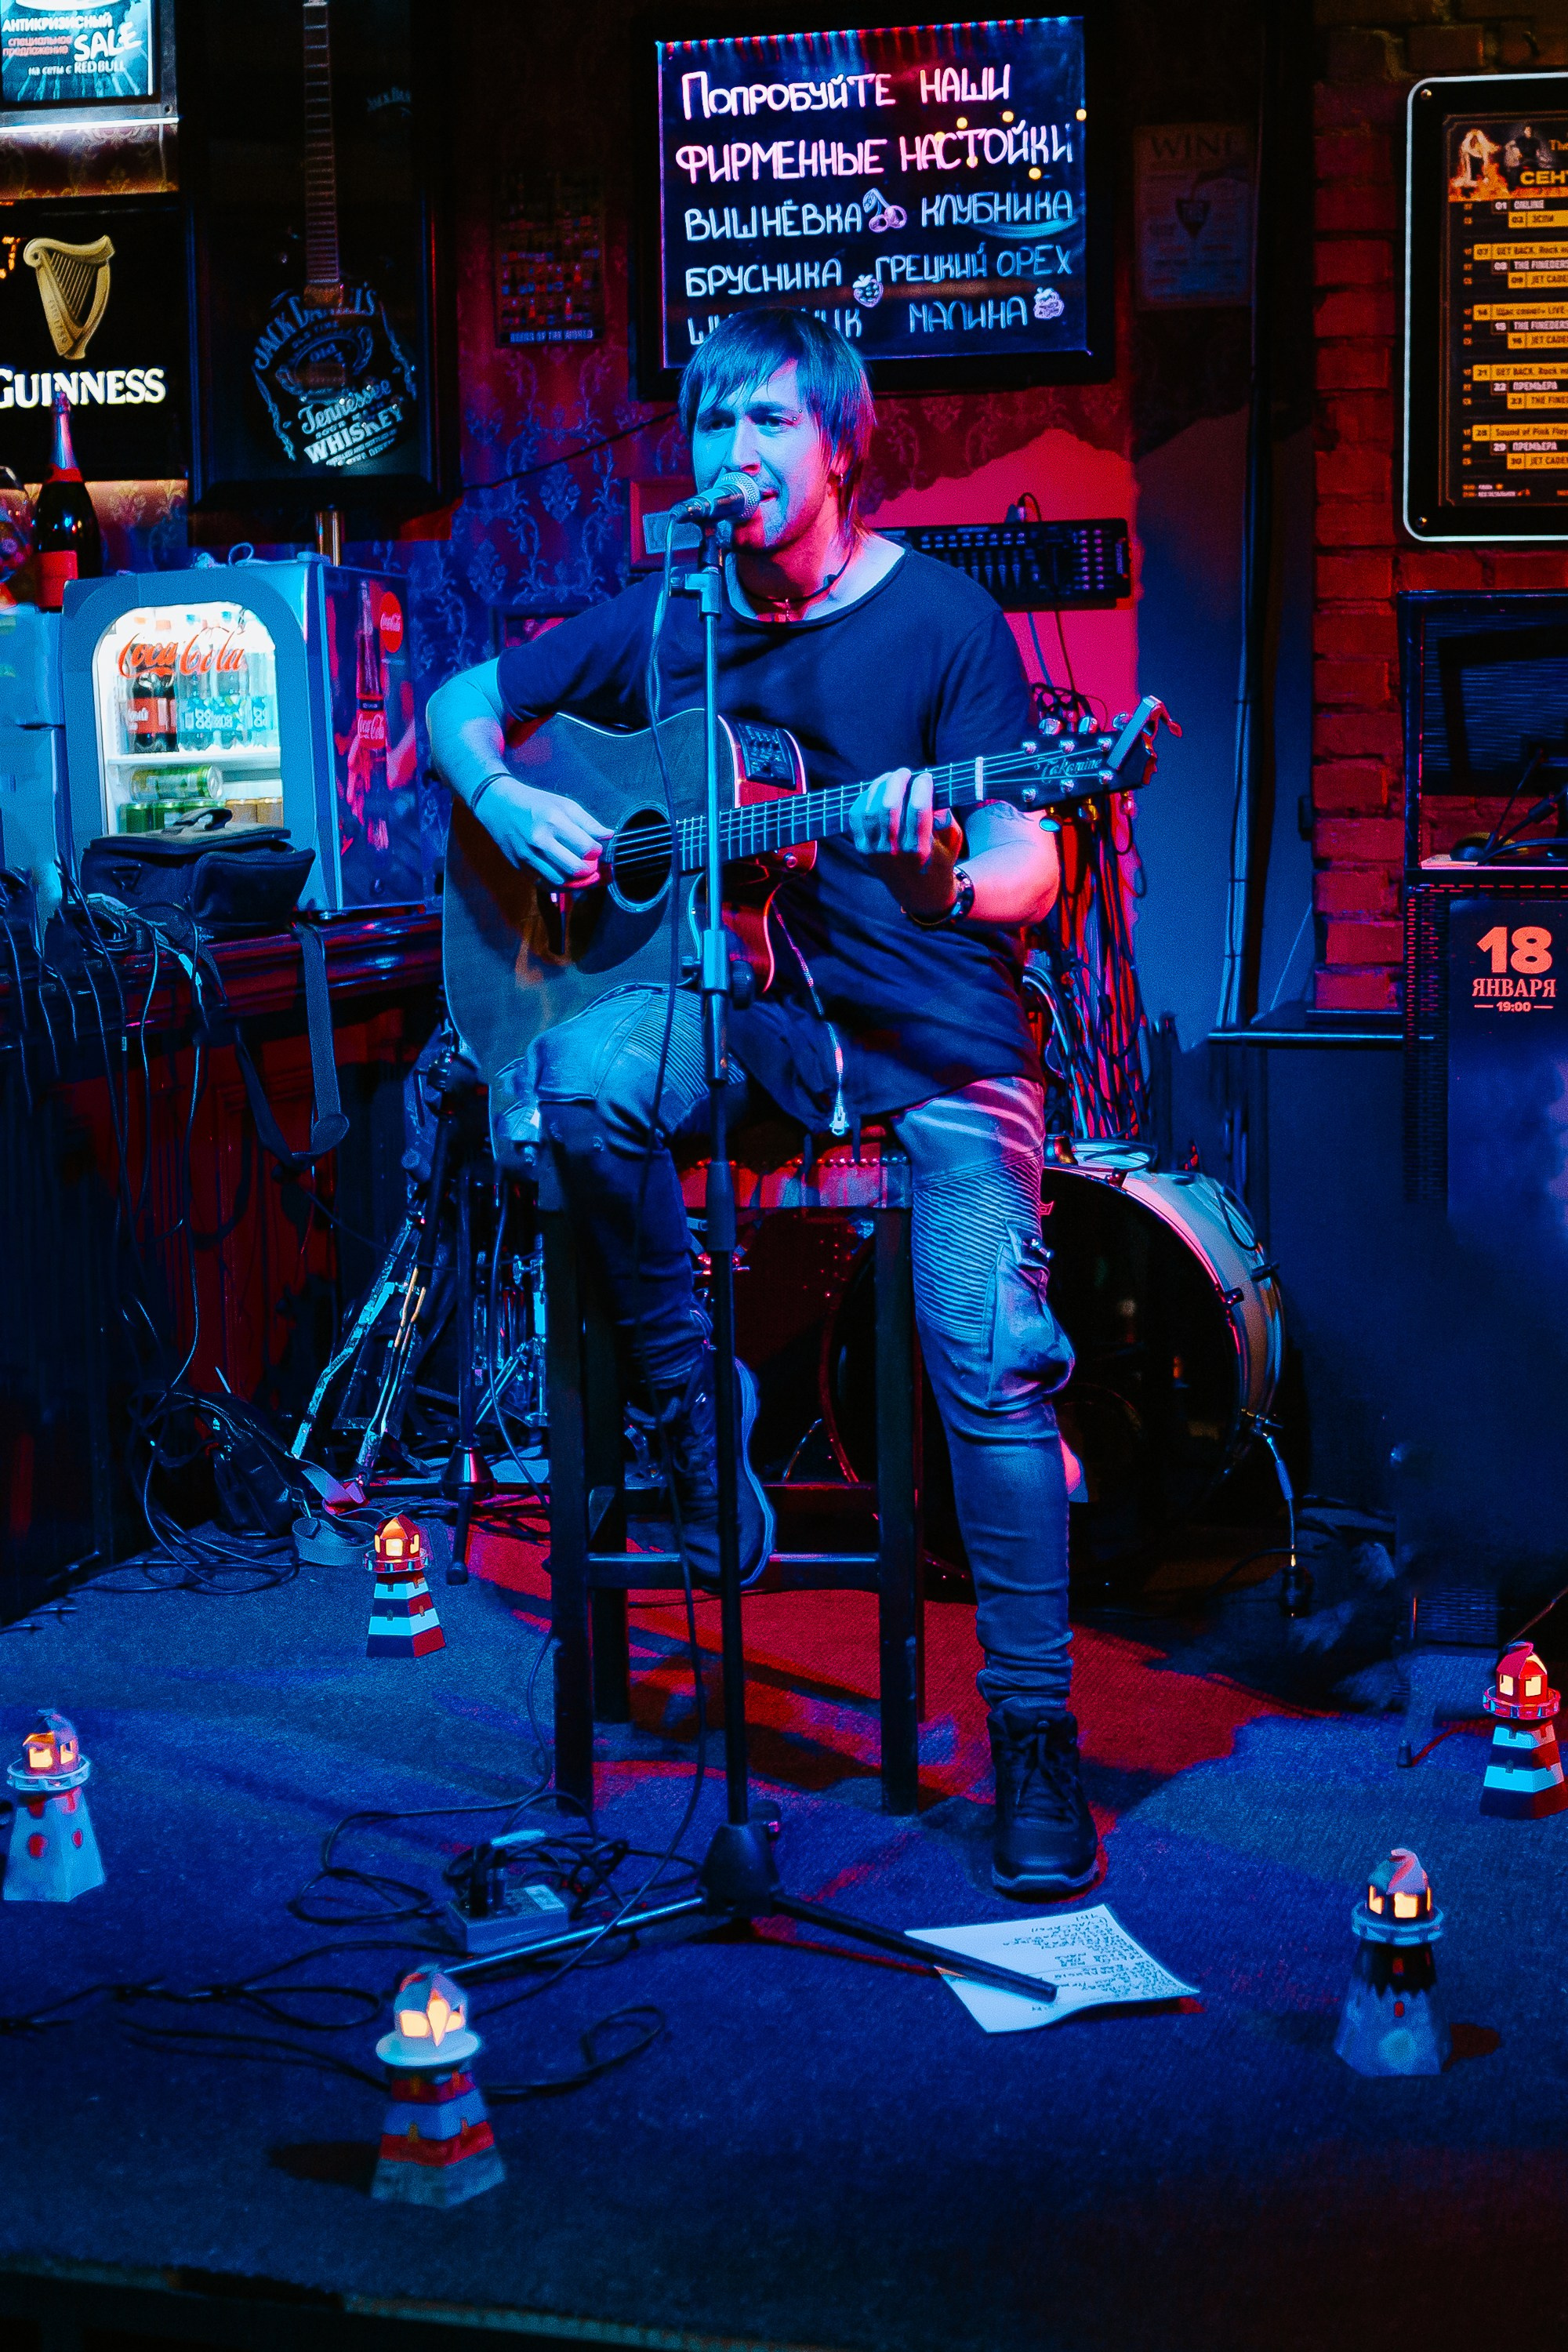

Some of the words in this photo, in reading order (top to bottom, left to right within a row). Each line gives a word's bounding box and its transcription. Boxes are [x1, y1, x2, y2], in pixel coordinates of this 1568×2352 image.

[74, 21, 143, 62] SALE
[919, 64, 1011, 104] НАШИ
[675, 139, 888, 183] ФИРМЕННЫЕ
[898, 120, 1074, 172] НАСТОЙКИ
[684, 201, 862, 241] ВИШНЁВКА
[920, 190, 1073, 227] КЛУБНИКА
[685, 258, 843, 297] БРУСНИКА
[874, 241, 988, 283] ГРЕЦКИЙ
[996, 245, 1073, 277] ОРЕХ
[909, 296, 1028, 333] МАЛИНА
[1477, 926, 1552, 975] 18
[1472, 978, 1556, 997] ЯНВАРЯ
[1496, 1001, 1531, 1012] 19:00
